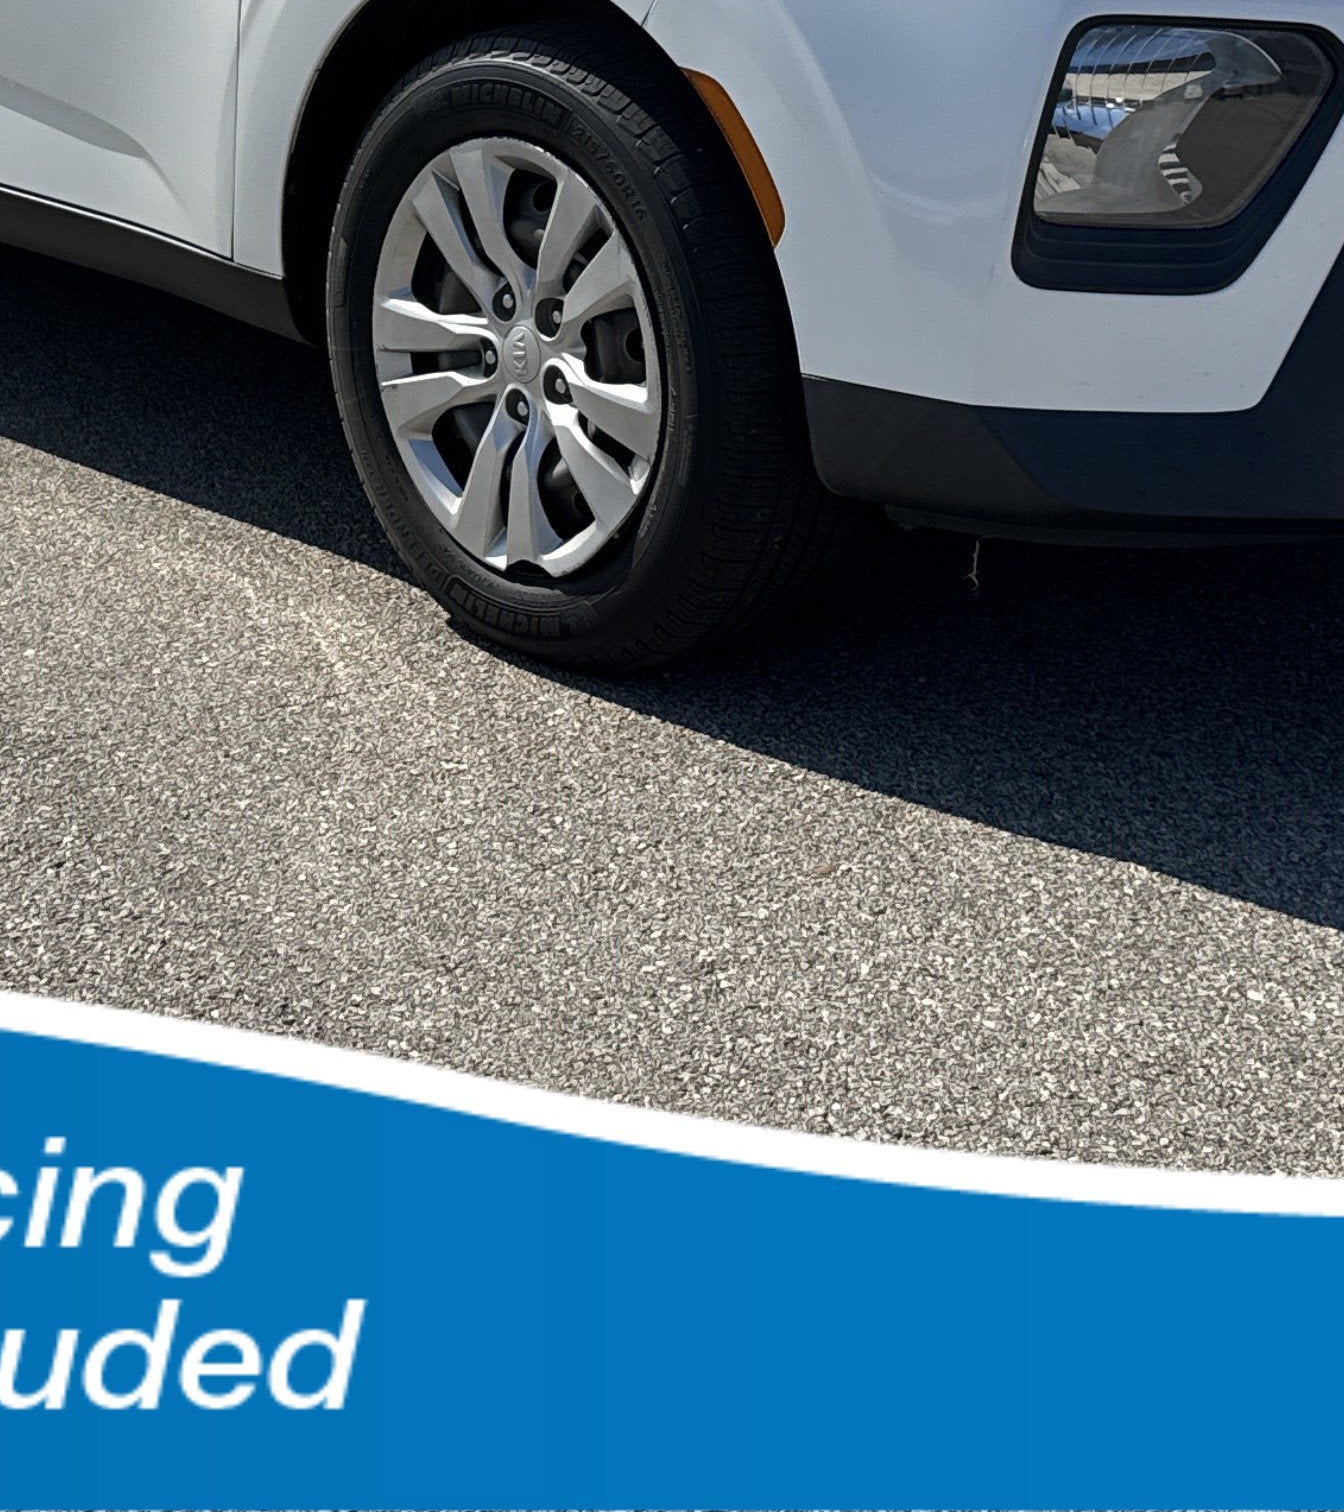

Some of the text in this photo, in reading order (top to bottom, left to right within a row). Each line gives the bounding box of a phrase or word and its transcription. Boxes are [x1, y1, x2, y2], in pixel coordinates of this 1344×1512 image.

[451, 83, 568, 130] MICHELIN
[511, 331, 528, 378] KIA
[447, 582, 561, 639] MICHELIN
